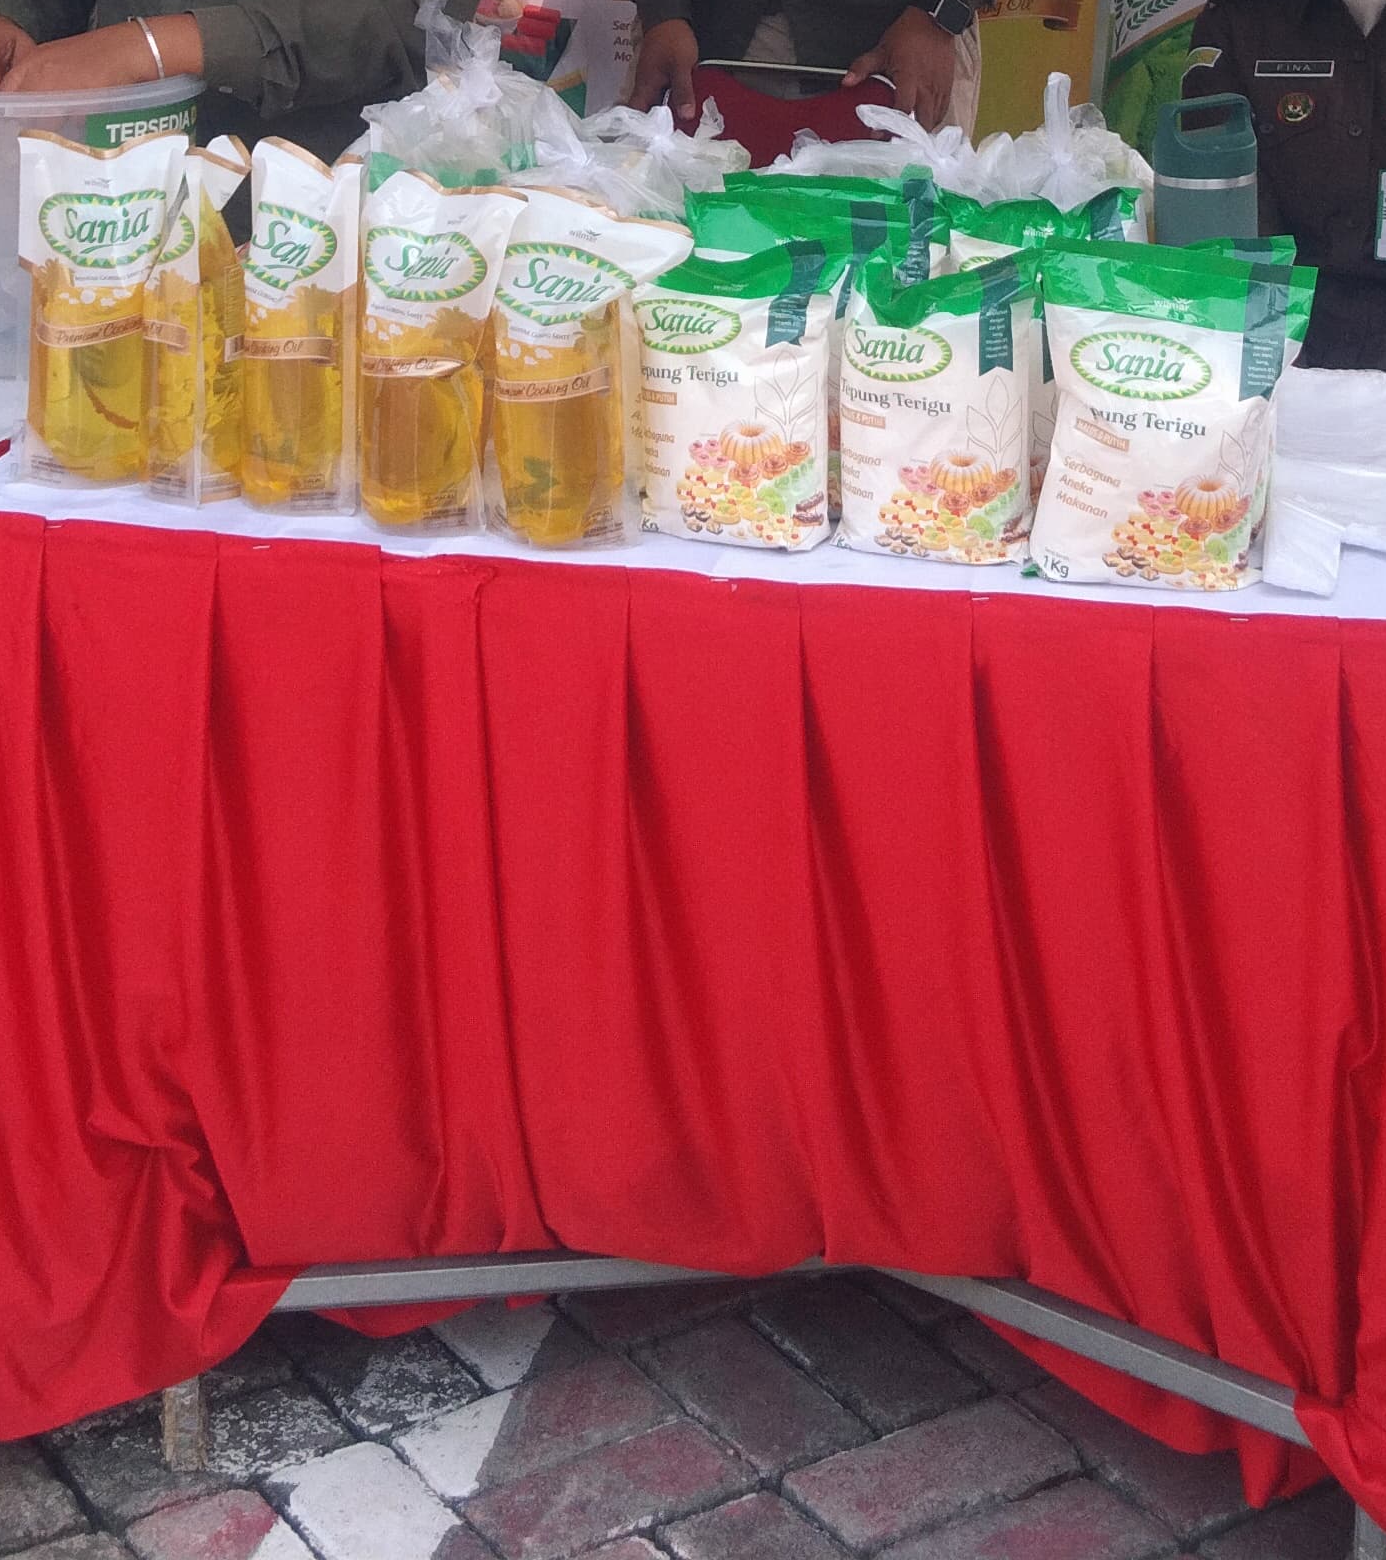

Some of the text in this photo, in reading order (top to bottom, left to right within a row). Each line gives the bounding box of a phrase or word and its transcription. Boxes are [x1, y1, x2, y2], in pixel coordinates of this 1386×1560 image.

[106, 109, 192, 143] TERSEDIA
[64, 206, 152, 245] Sania
[512, 257, 615, 303] Sania
[1153, 299, 1189, 311] wilmar
[644, 305, 720, 335] Sania
[853, 326, 926, 363] Sania
[641, 364, 740, 387] epung Terigu
[1095, 342, 1186, 382] Sania
[571, 375, 591, 390] Oil
[892, 392, 952, 417] Terigu
[1142, 412, 1207, 438] Terigu
[1059, 473, 1094, 496] Aneka
[1063, 455, 1121, 488] Serbaguna
[1056, 492, 1109, 519] Makanan
